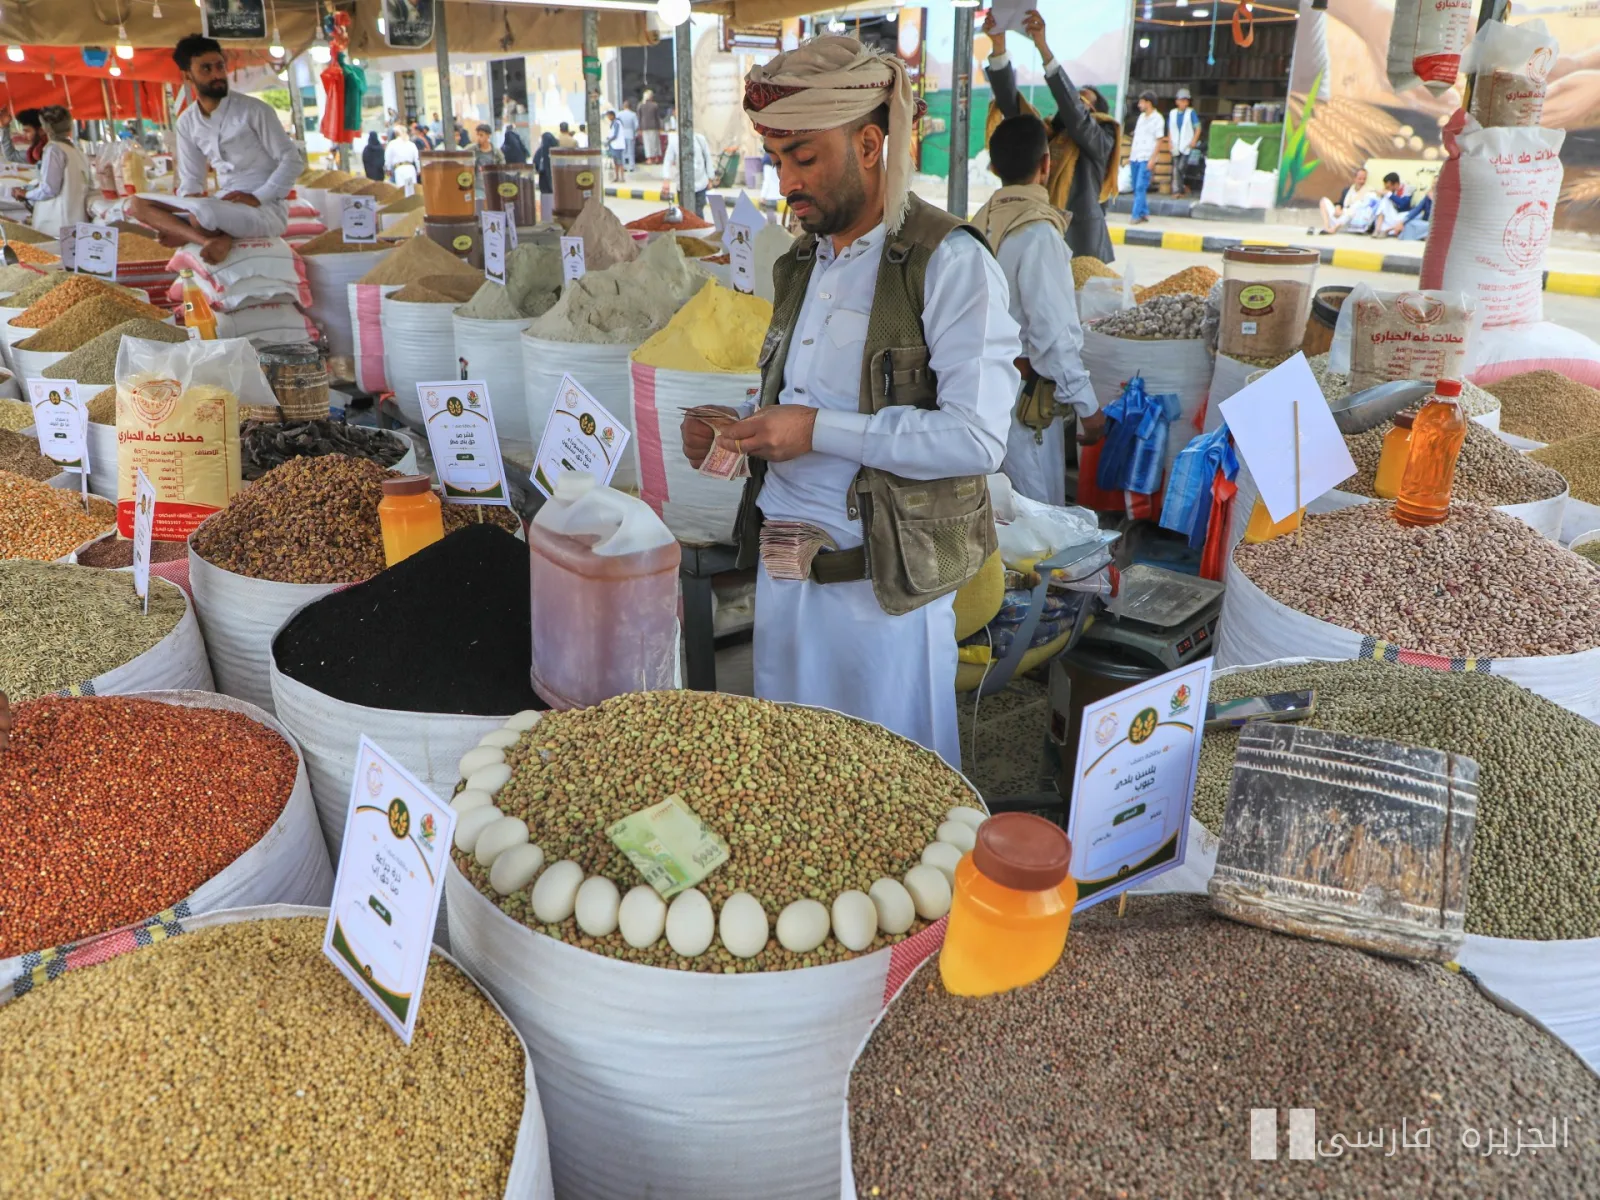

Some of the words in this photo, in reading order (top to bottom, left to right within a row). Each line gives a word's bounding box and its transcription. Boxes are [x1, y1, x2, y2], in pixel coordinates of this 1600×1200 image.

[1370, 331, 1411, 345] الحباري
[1412, 332, 1430, 342] طه
[1432, 333, 1464, 343] محلات
[118, 430, 144, 445] الحباري
[145, 431, 161, 443] طه
[163, 431, 204, 443] محلات
[1134, 777, 1156, 792] حبوب
